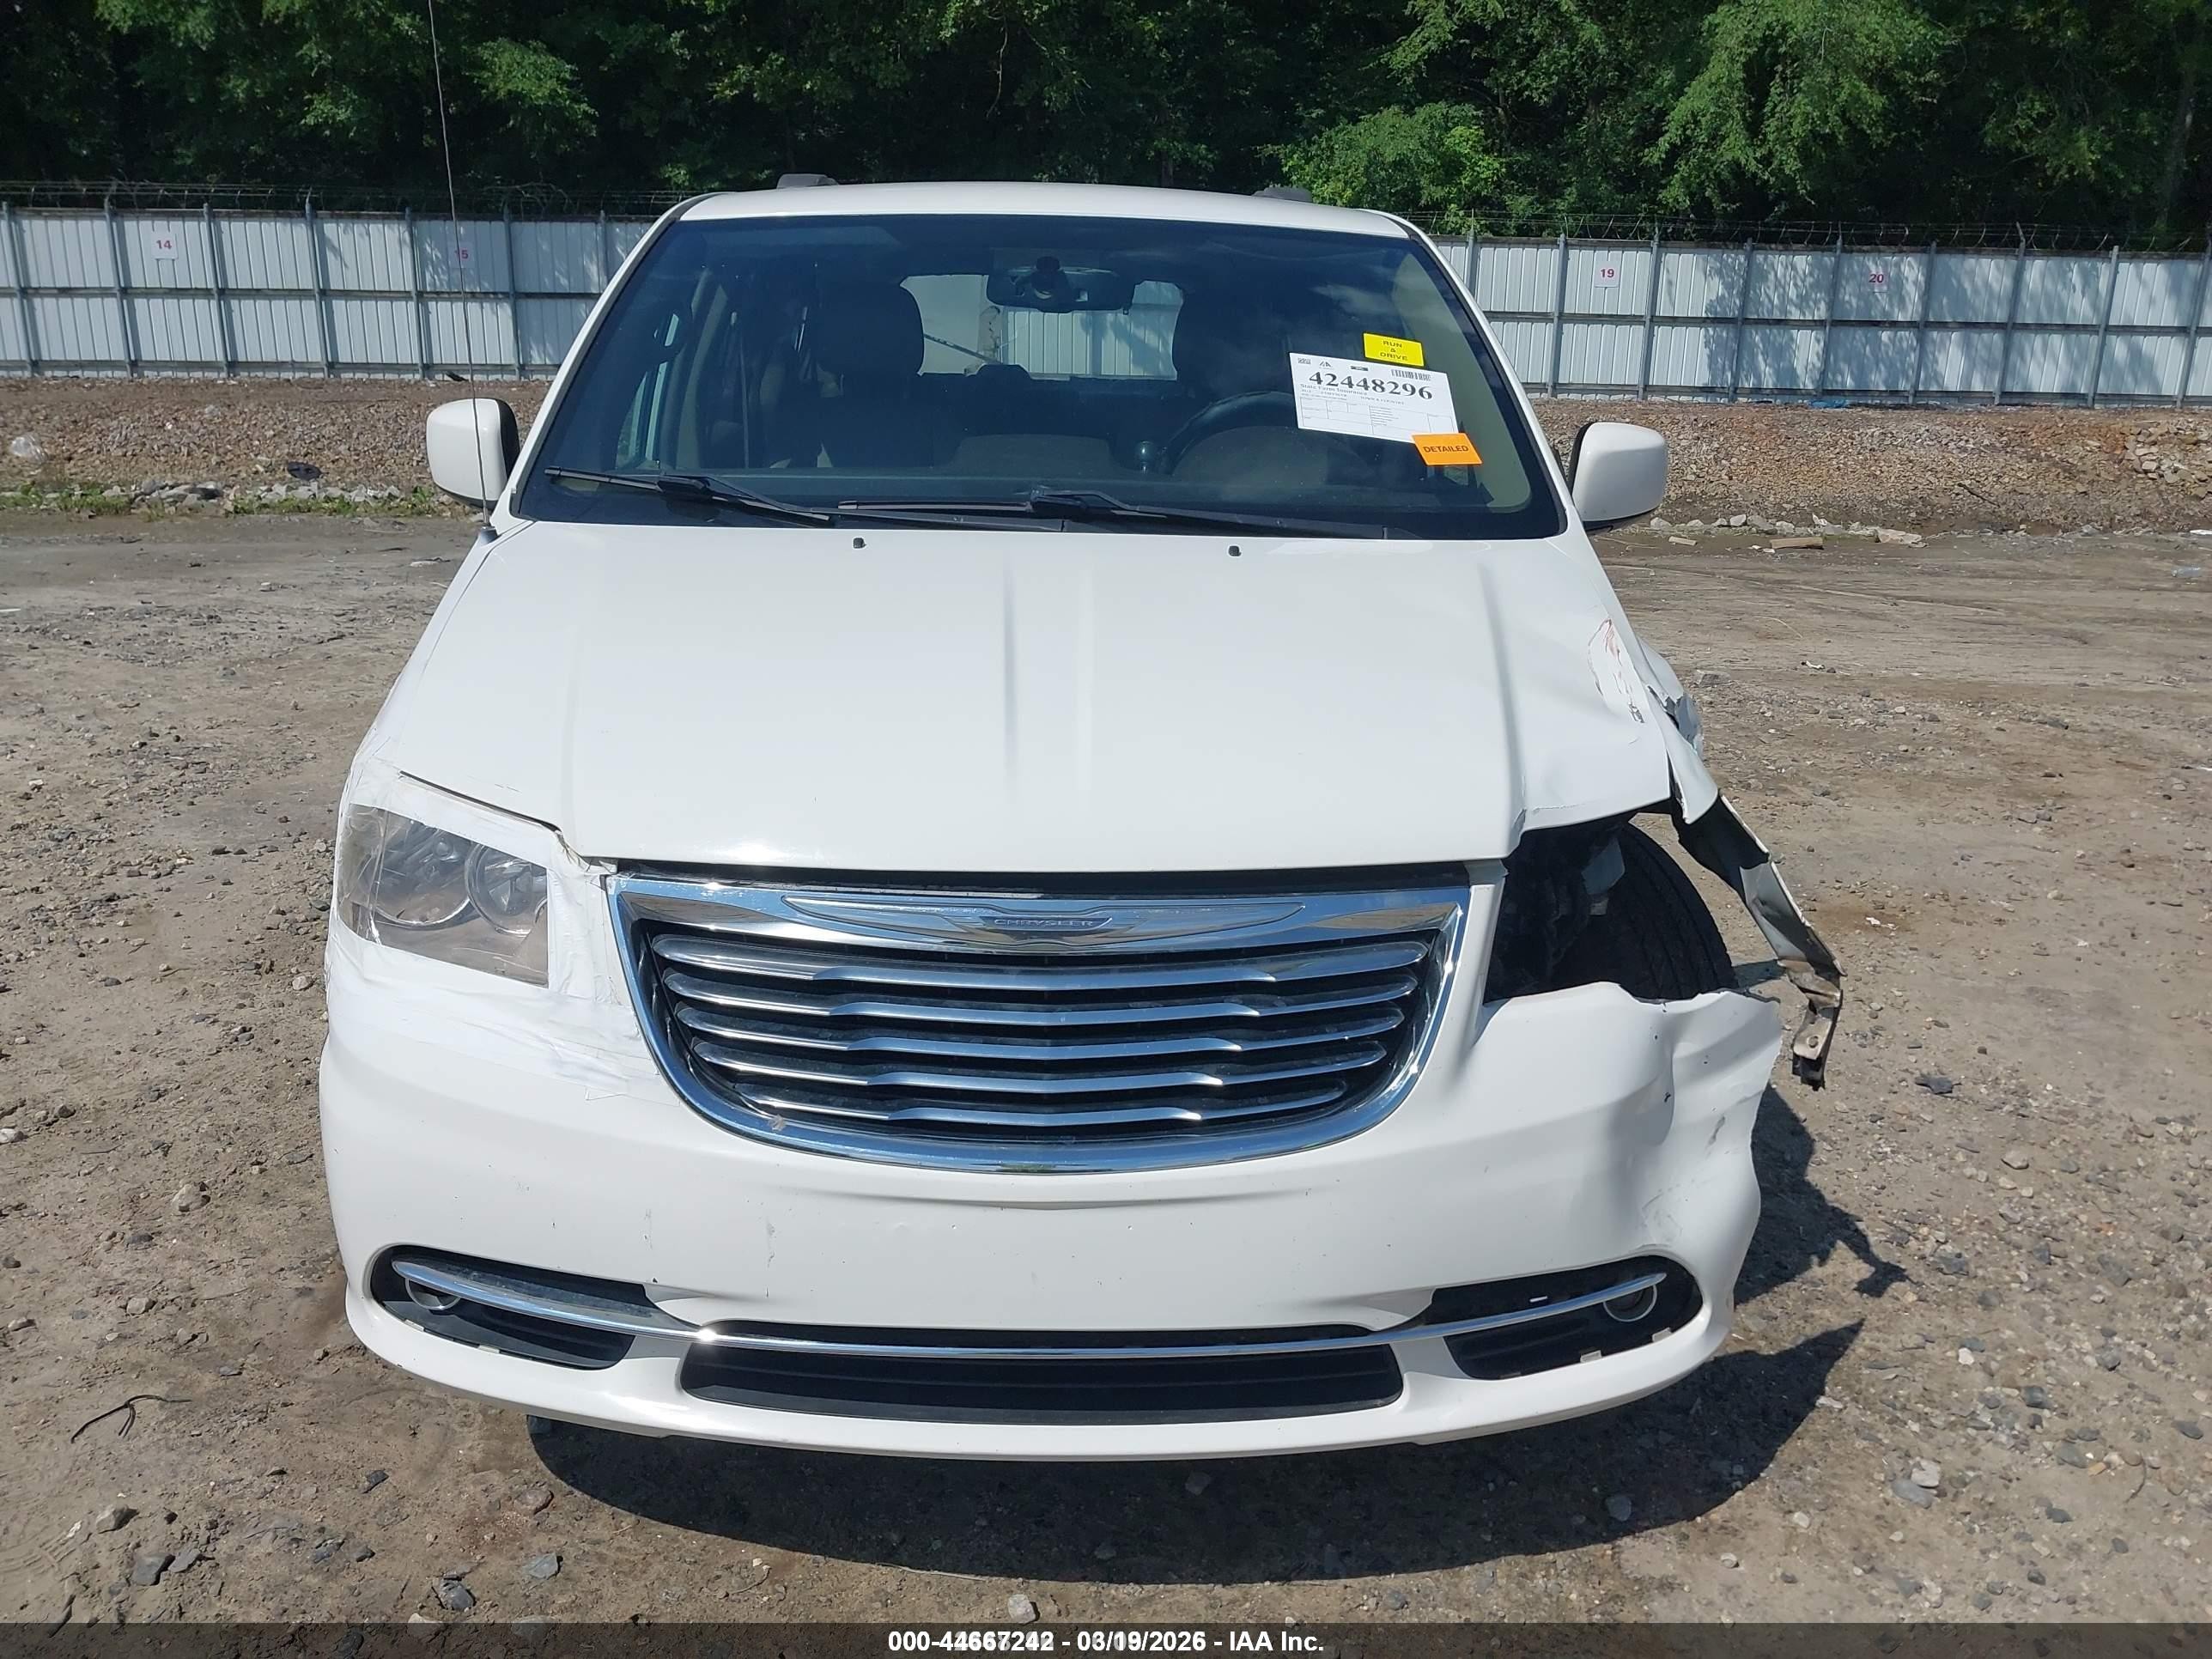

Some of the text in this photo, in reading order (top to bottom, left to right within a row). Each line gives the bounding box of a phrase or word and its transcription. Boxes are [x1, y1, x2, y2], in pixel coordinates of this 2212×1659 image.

[155, 240, 173, 250] 14
[1600, 268, 1615, 278] 19
[1868, 273, 1884, 283] 20
[1382, 339, 1402, 348] RUN
[1380, 351, 1408, 361] DRIVE
[1309, 371, 1433, 400] 42448296
[1423, 445, 1469, 453] DETAILED
